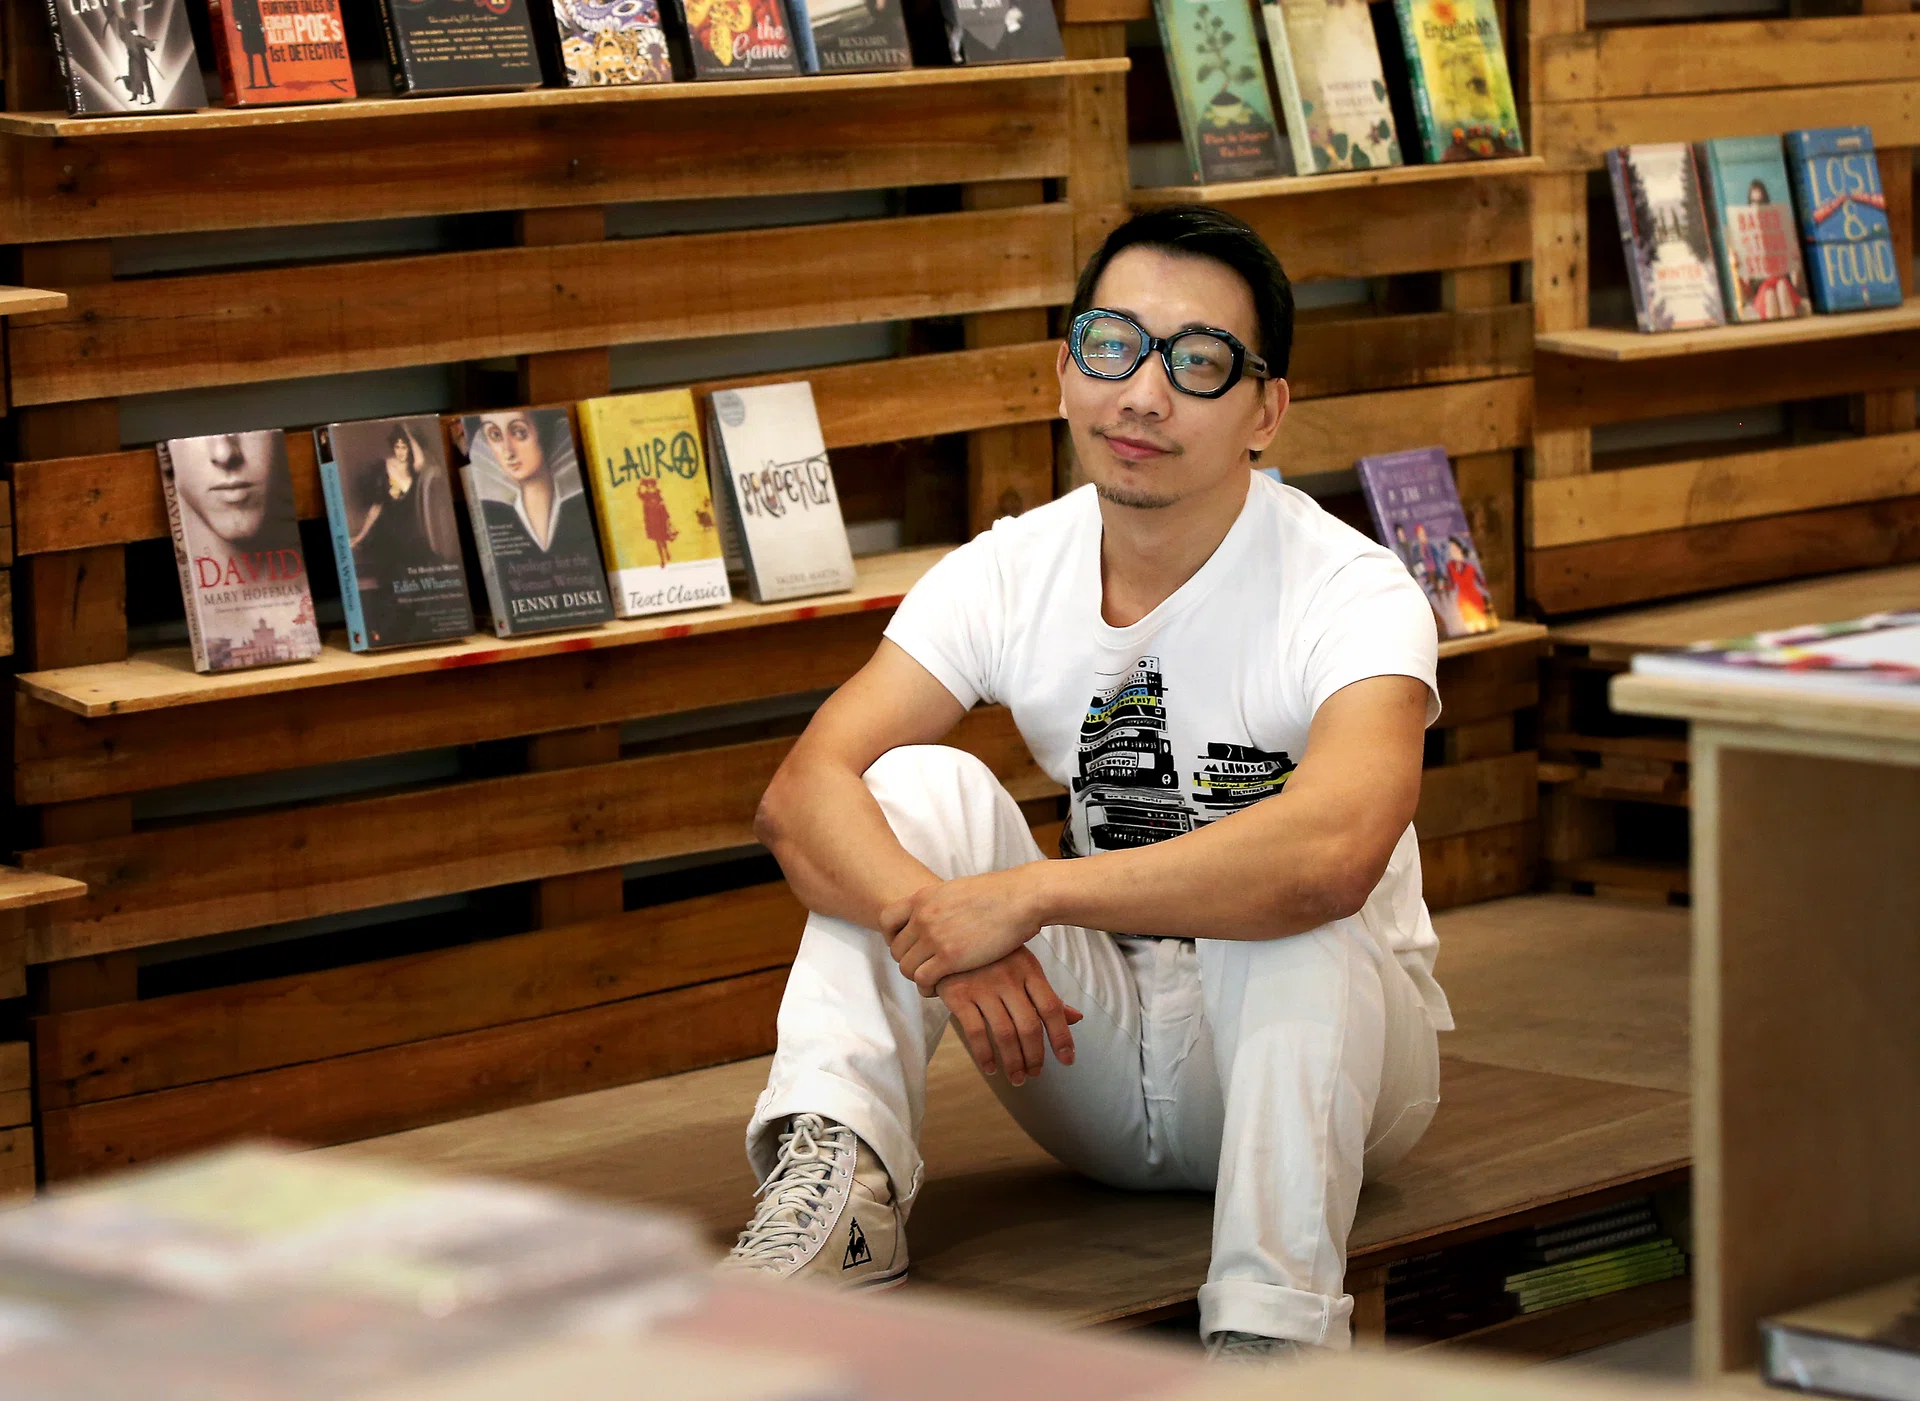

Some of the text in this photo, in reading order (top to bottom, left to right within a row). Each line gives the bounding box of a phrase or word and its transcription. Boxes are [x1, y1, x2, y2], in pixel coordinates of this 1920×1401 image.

[757, 15, 785, 41] the
[268, 42, 346, 62] 1st DETECTIVE
[732, 33, 790, 69] Game
[822, 48, 907, 66] MARKOVITS
[1807, 153, 1876, 209] LOST
[1842, 199, 1868, 241] &
[1823, 239, 1894, 288] FOUND
[606, 431, 700, 488] LAURA
[166, 484, 184, 543] DAVID
[194, 548, 304, 589] DAVID
[204, 583, 303, 606] MARY HOFFMAN
[511, 594, 560, 616] JENNY
[562, 590, 604, 608] DISKI
[628, 581, 727, 609] Text Classics
[1117, 697, 1152, 707] JOURNEY
